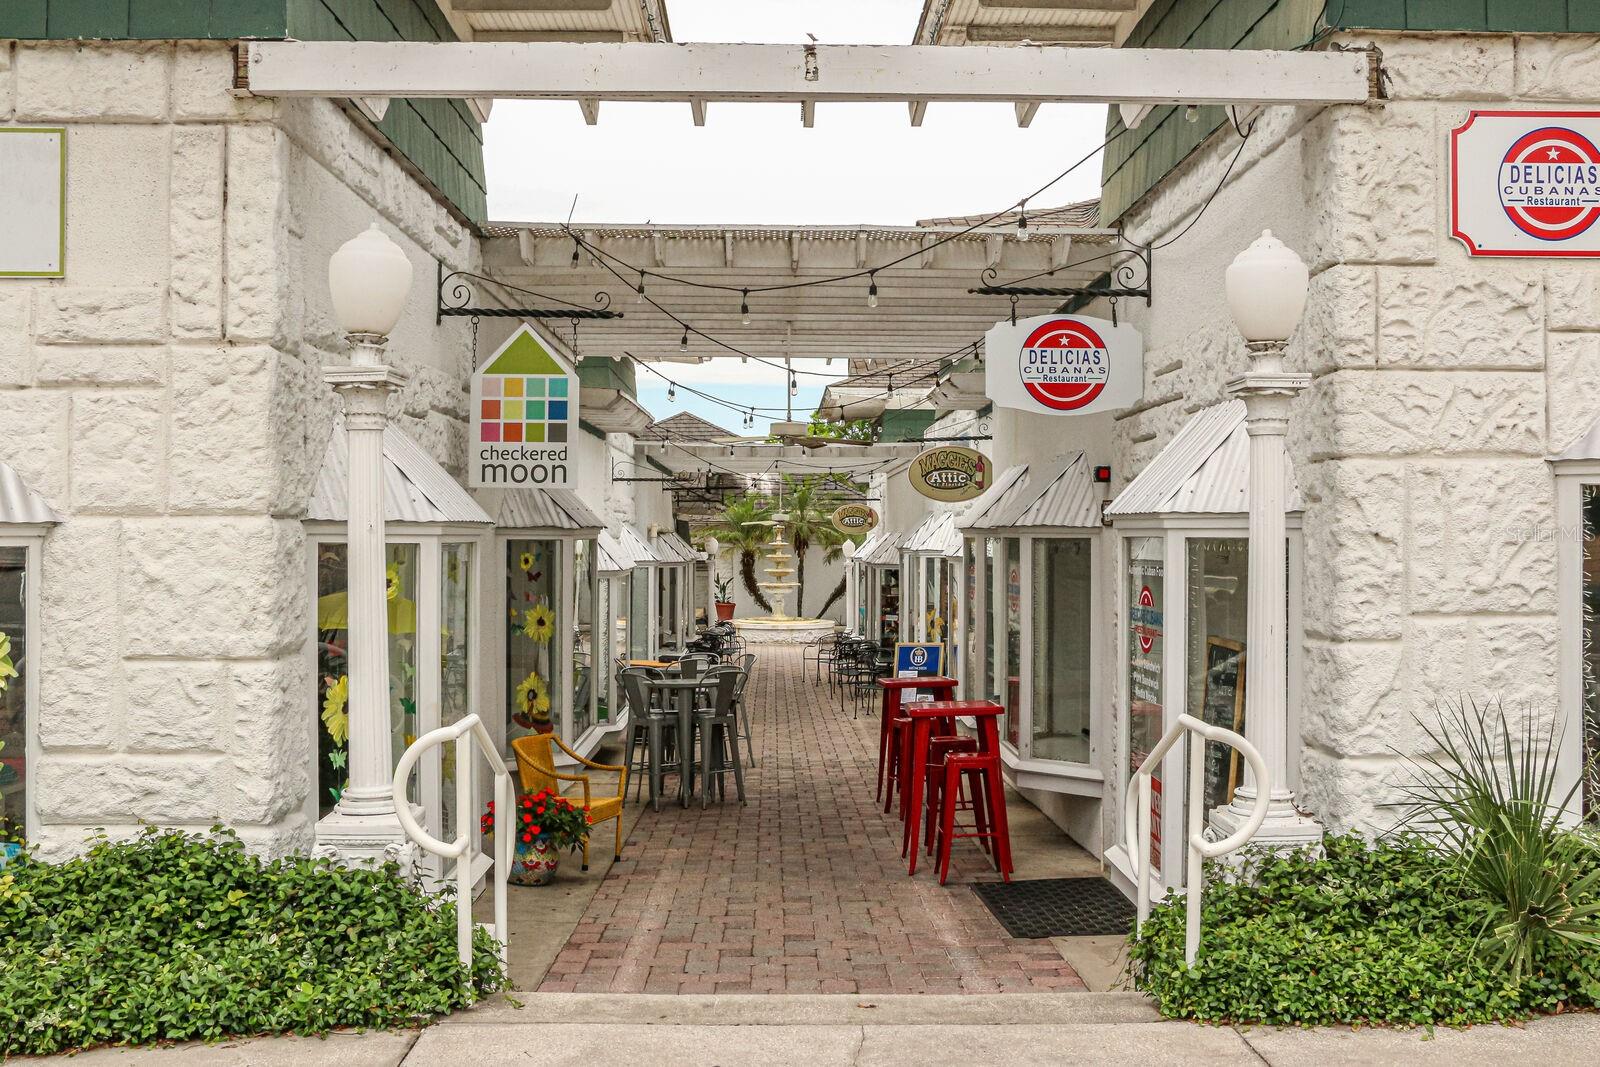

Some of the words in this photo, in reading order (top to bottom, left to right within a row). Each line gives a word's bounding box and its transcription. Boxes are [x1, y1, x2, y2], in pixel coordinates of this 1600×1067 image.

[1510, 165, 1597, 184] DELICIAS
[1504, 186, 1600, 196] CUBANAS
[1526, 196, 1580, 206] Restaurant
[1029, 349, 1101, 365] DELICIAS
[1023, 366, 1106, 375] CUBANAS
[1042, 374, 1087, 383] Restaurant
[480, 445, 568, 461] checkered
[481, 463, 567, 484] moon
[931, 472, 967, 483] Attic
